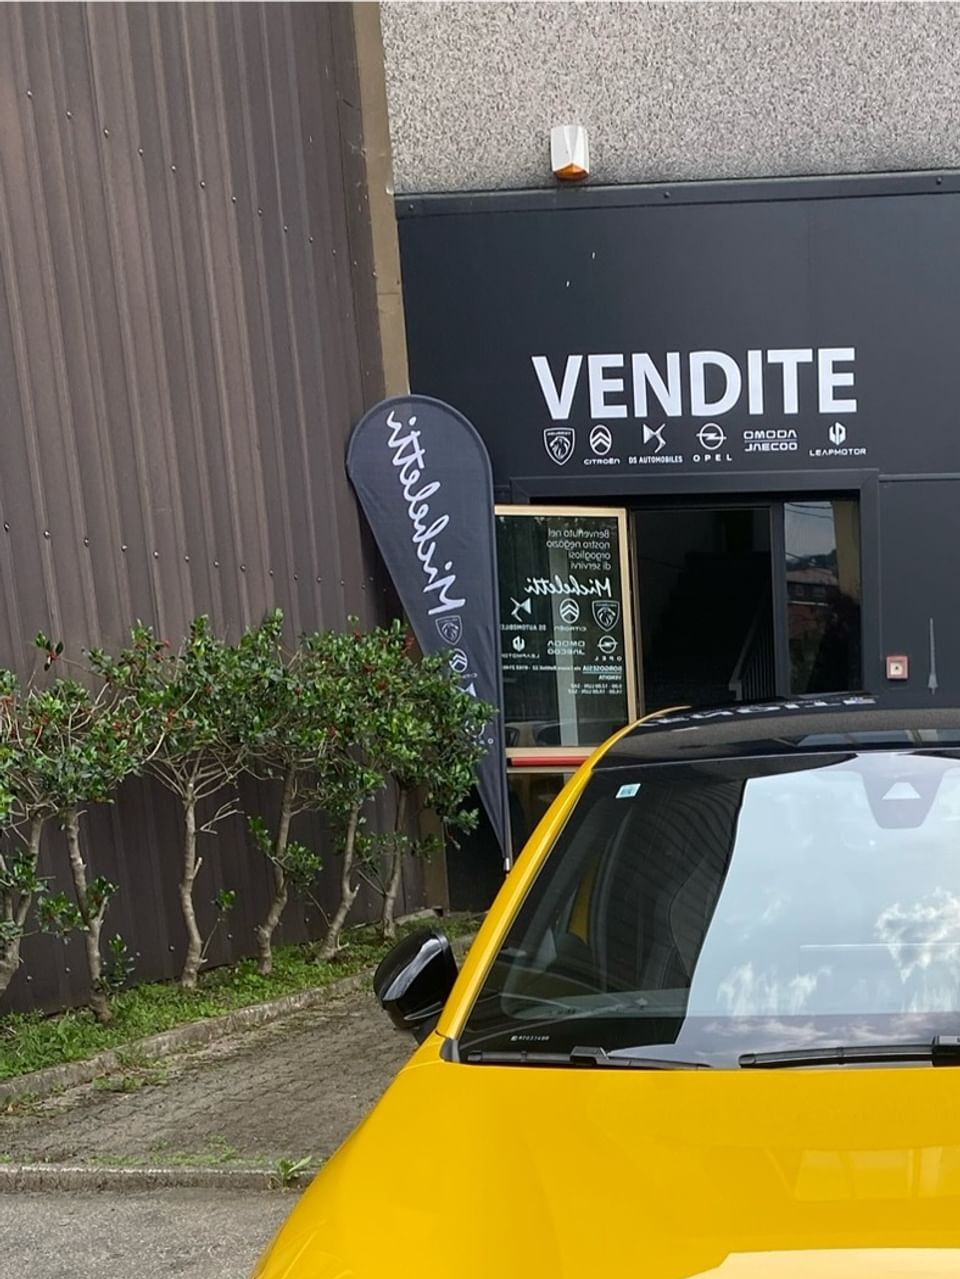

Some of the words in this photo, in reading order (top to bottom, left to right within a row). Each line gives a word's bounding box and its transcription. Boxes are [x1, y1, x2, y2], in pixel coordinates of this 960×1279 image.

[531, 347, 857, 420] VENDITE
[743, 429, 798, 440] OMODA
[744, 442, 798, 452] JAECOO
[809, 447, 867, 457] LEAPMOTOR
[628, 455, 638, 464] DS
[639, 454, 684, 464] AUTOMOBILES
[692, 453, 733, 463] OPEL
